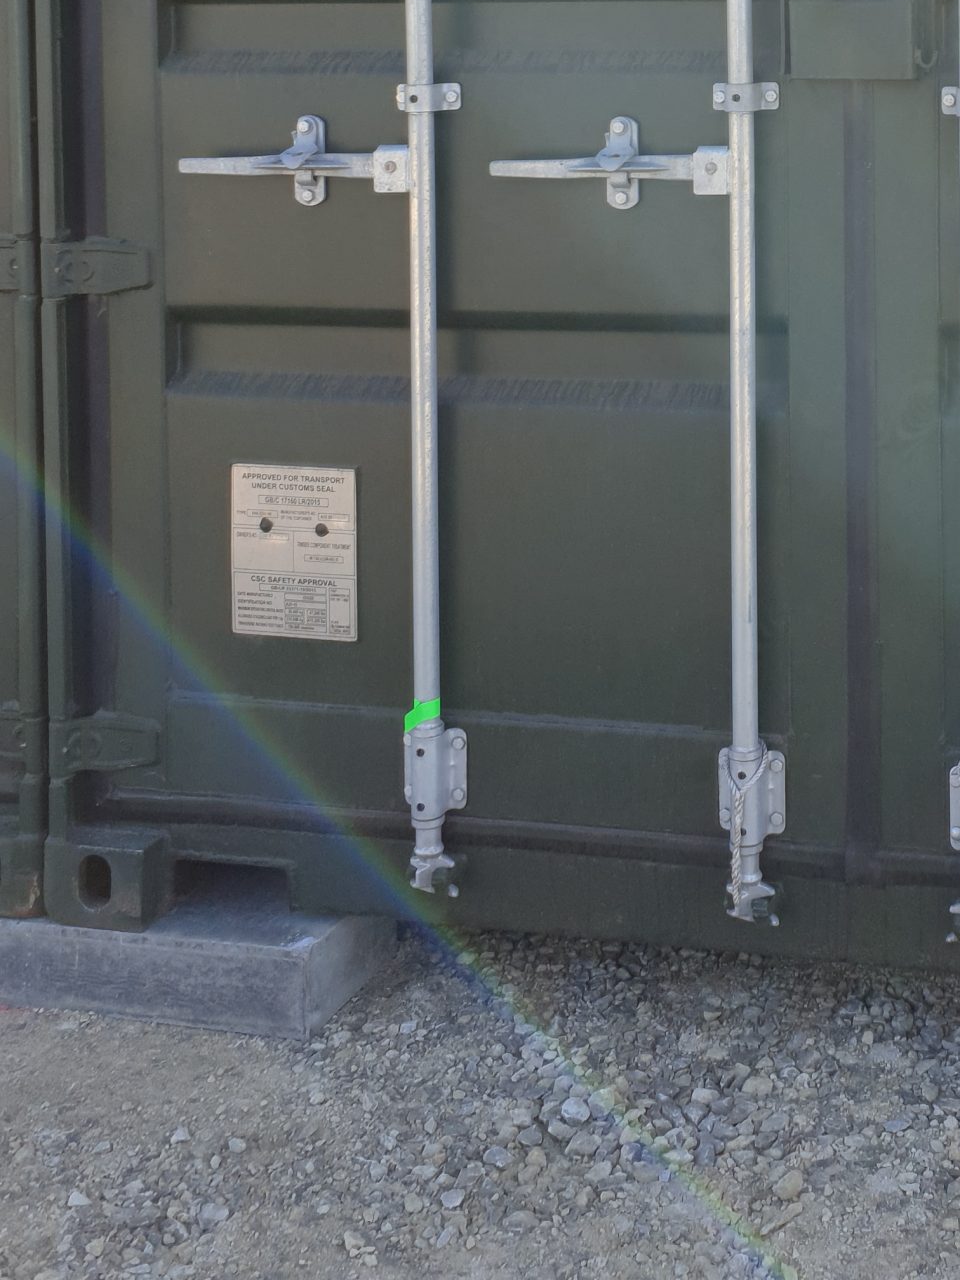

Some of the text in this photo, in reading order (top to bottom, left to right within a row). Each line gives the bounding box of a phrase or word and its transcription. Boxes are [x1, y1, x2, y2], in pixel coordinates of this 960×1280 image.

[241, 472, 345, 484] APPROVED FOR TRANSPORT
[251, 482, 336, 493] UNDER CUSTOMS SEAL
[250, 575, 337, 587] CSC SAFETY APPROVAL
